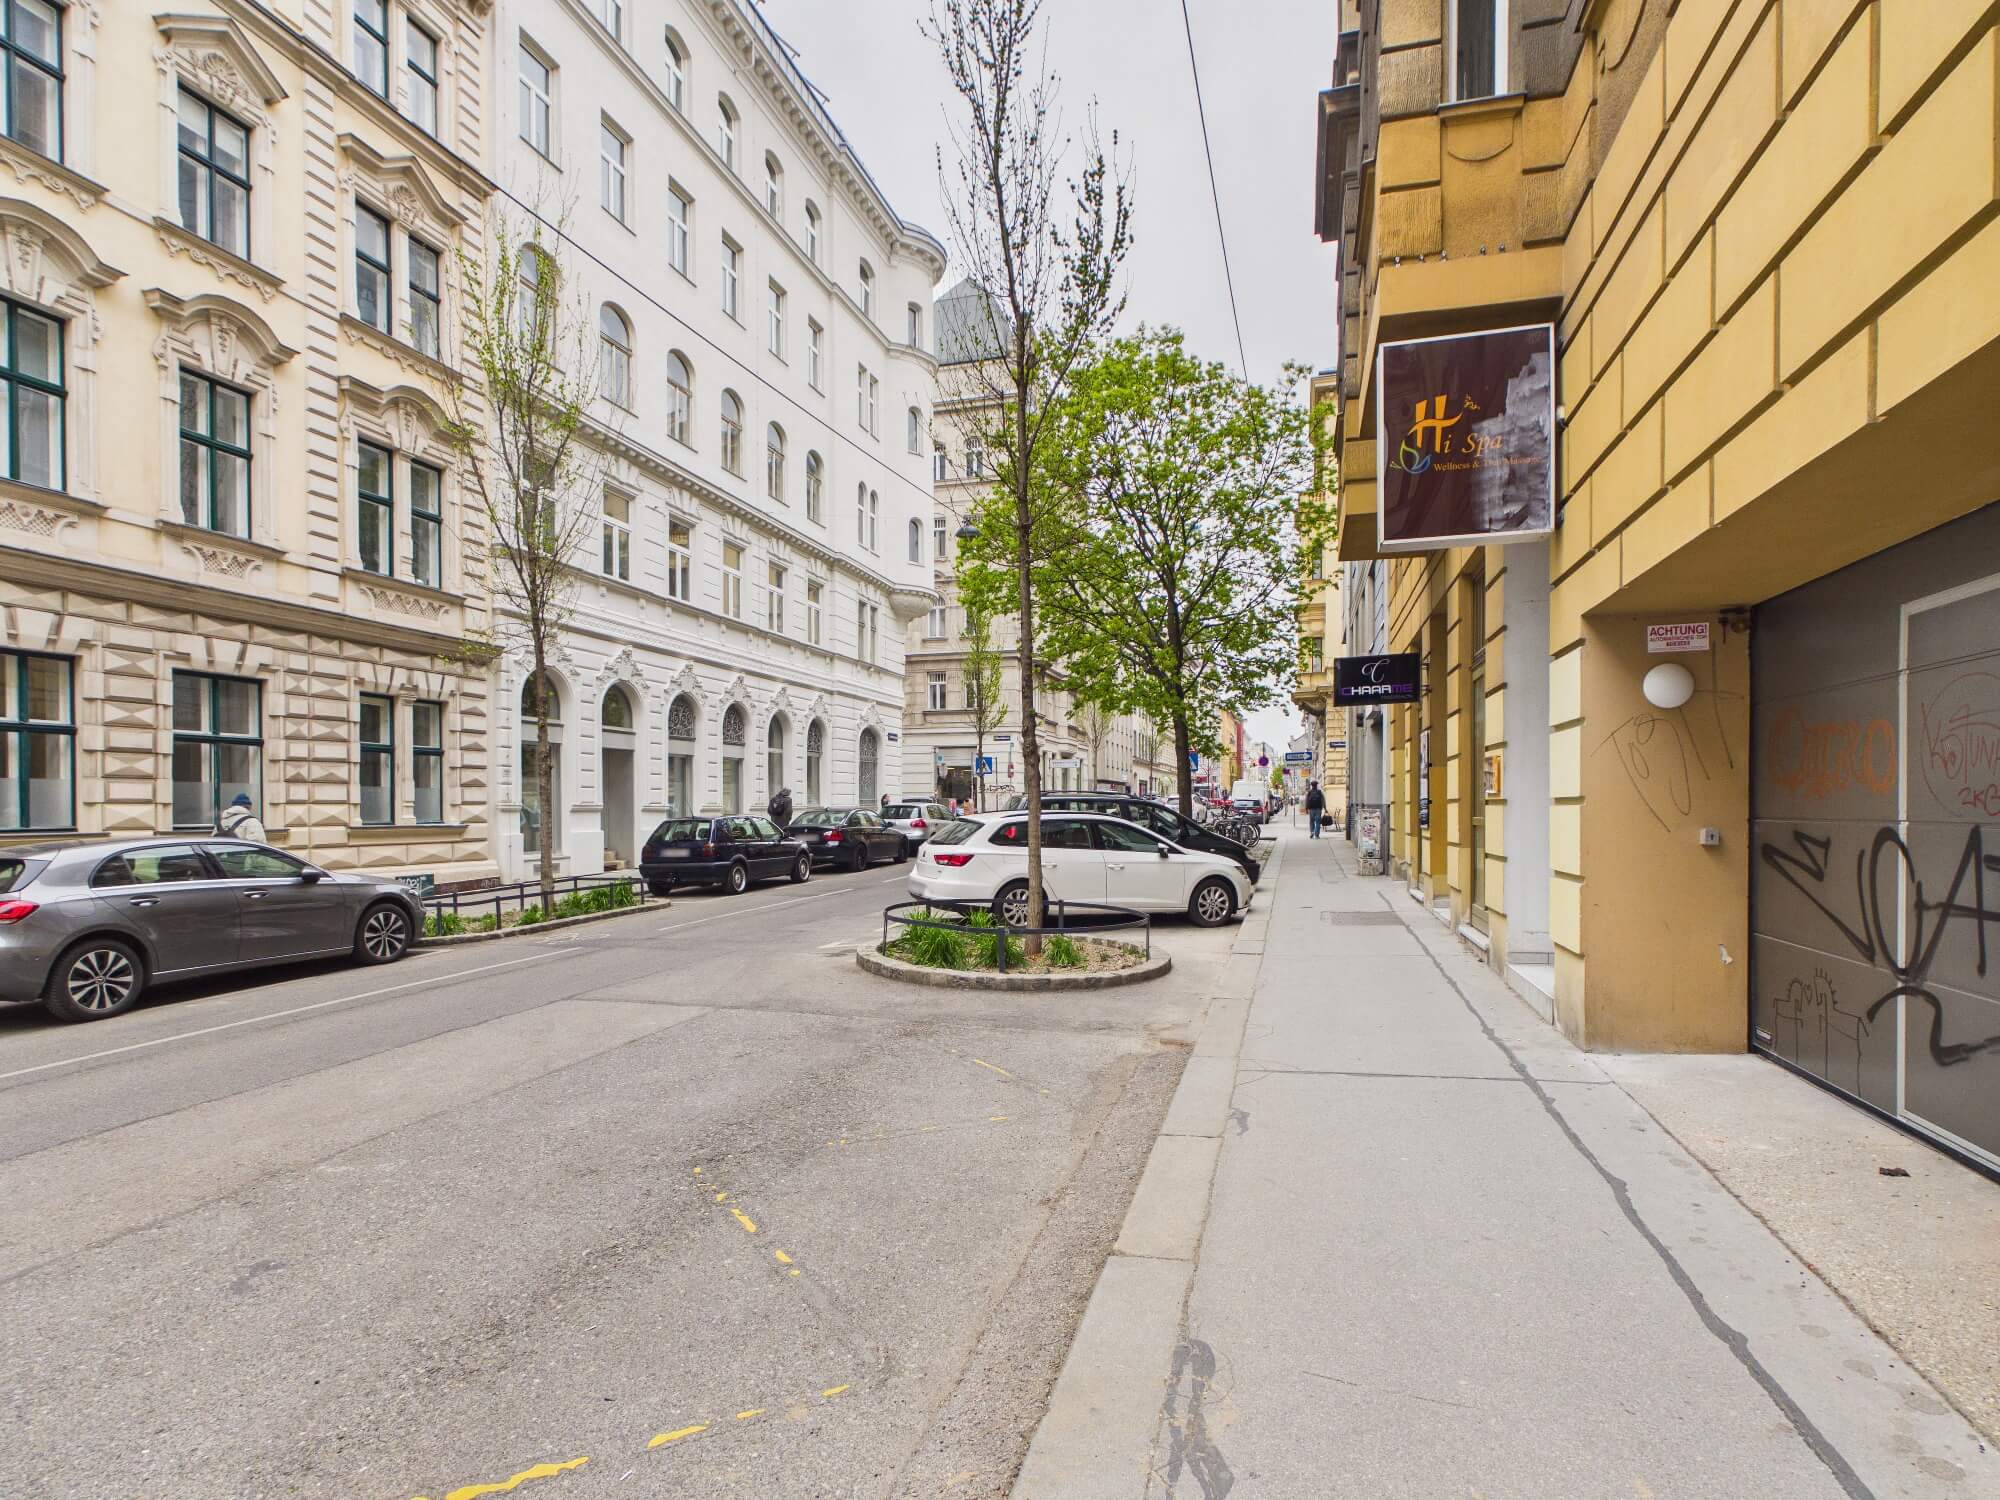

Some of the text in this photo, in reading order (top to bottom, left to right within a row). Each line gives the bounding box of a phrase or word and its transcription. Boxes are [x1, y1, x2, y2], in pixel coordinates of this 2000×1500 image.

[1408, 394, 1503, 457] Hi Spa
[1433, 461, 1469, 472] Wellness
[1649, 624, 1707, 637] ACHTUNG!
